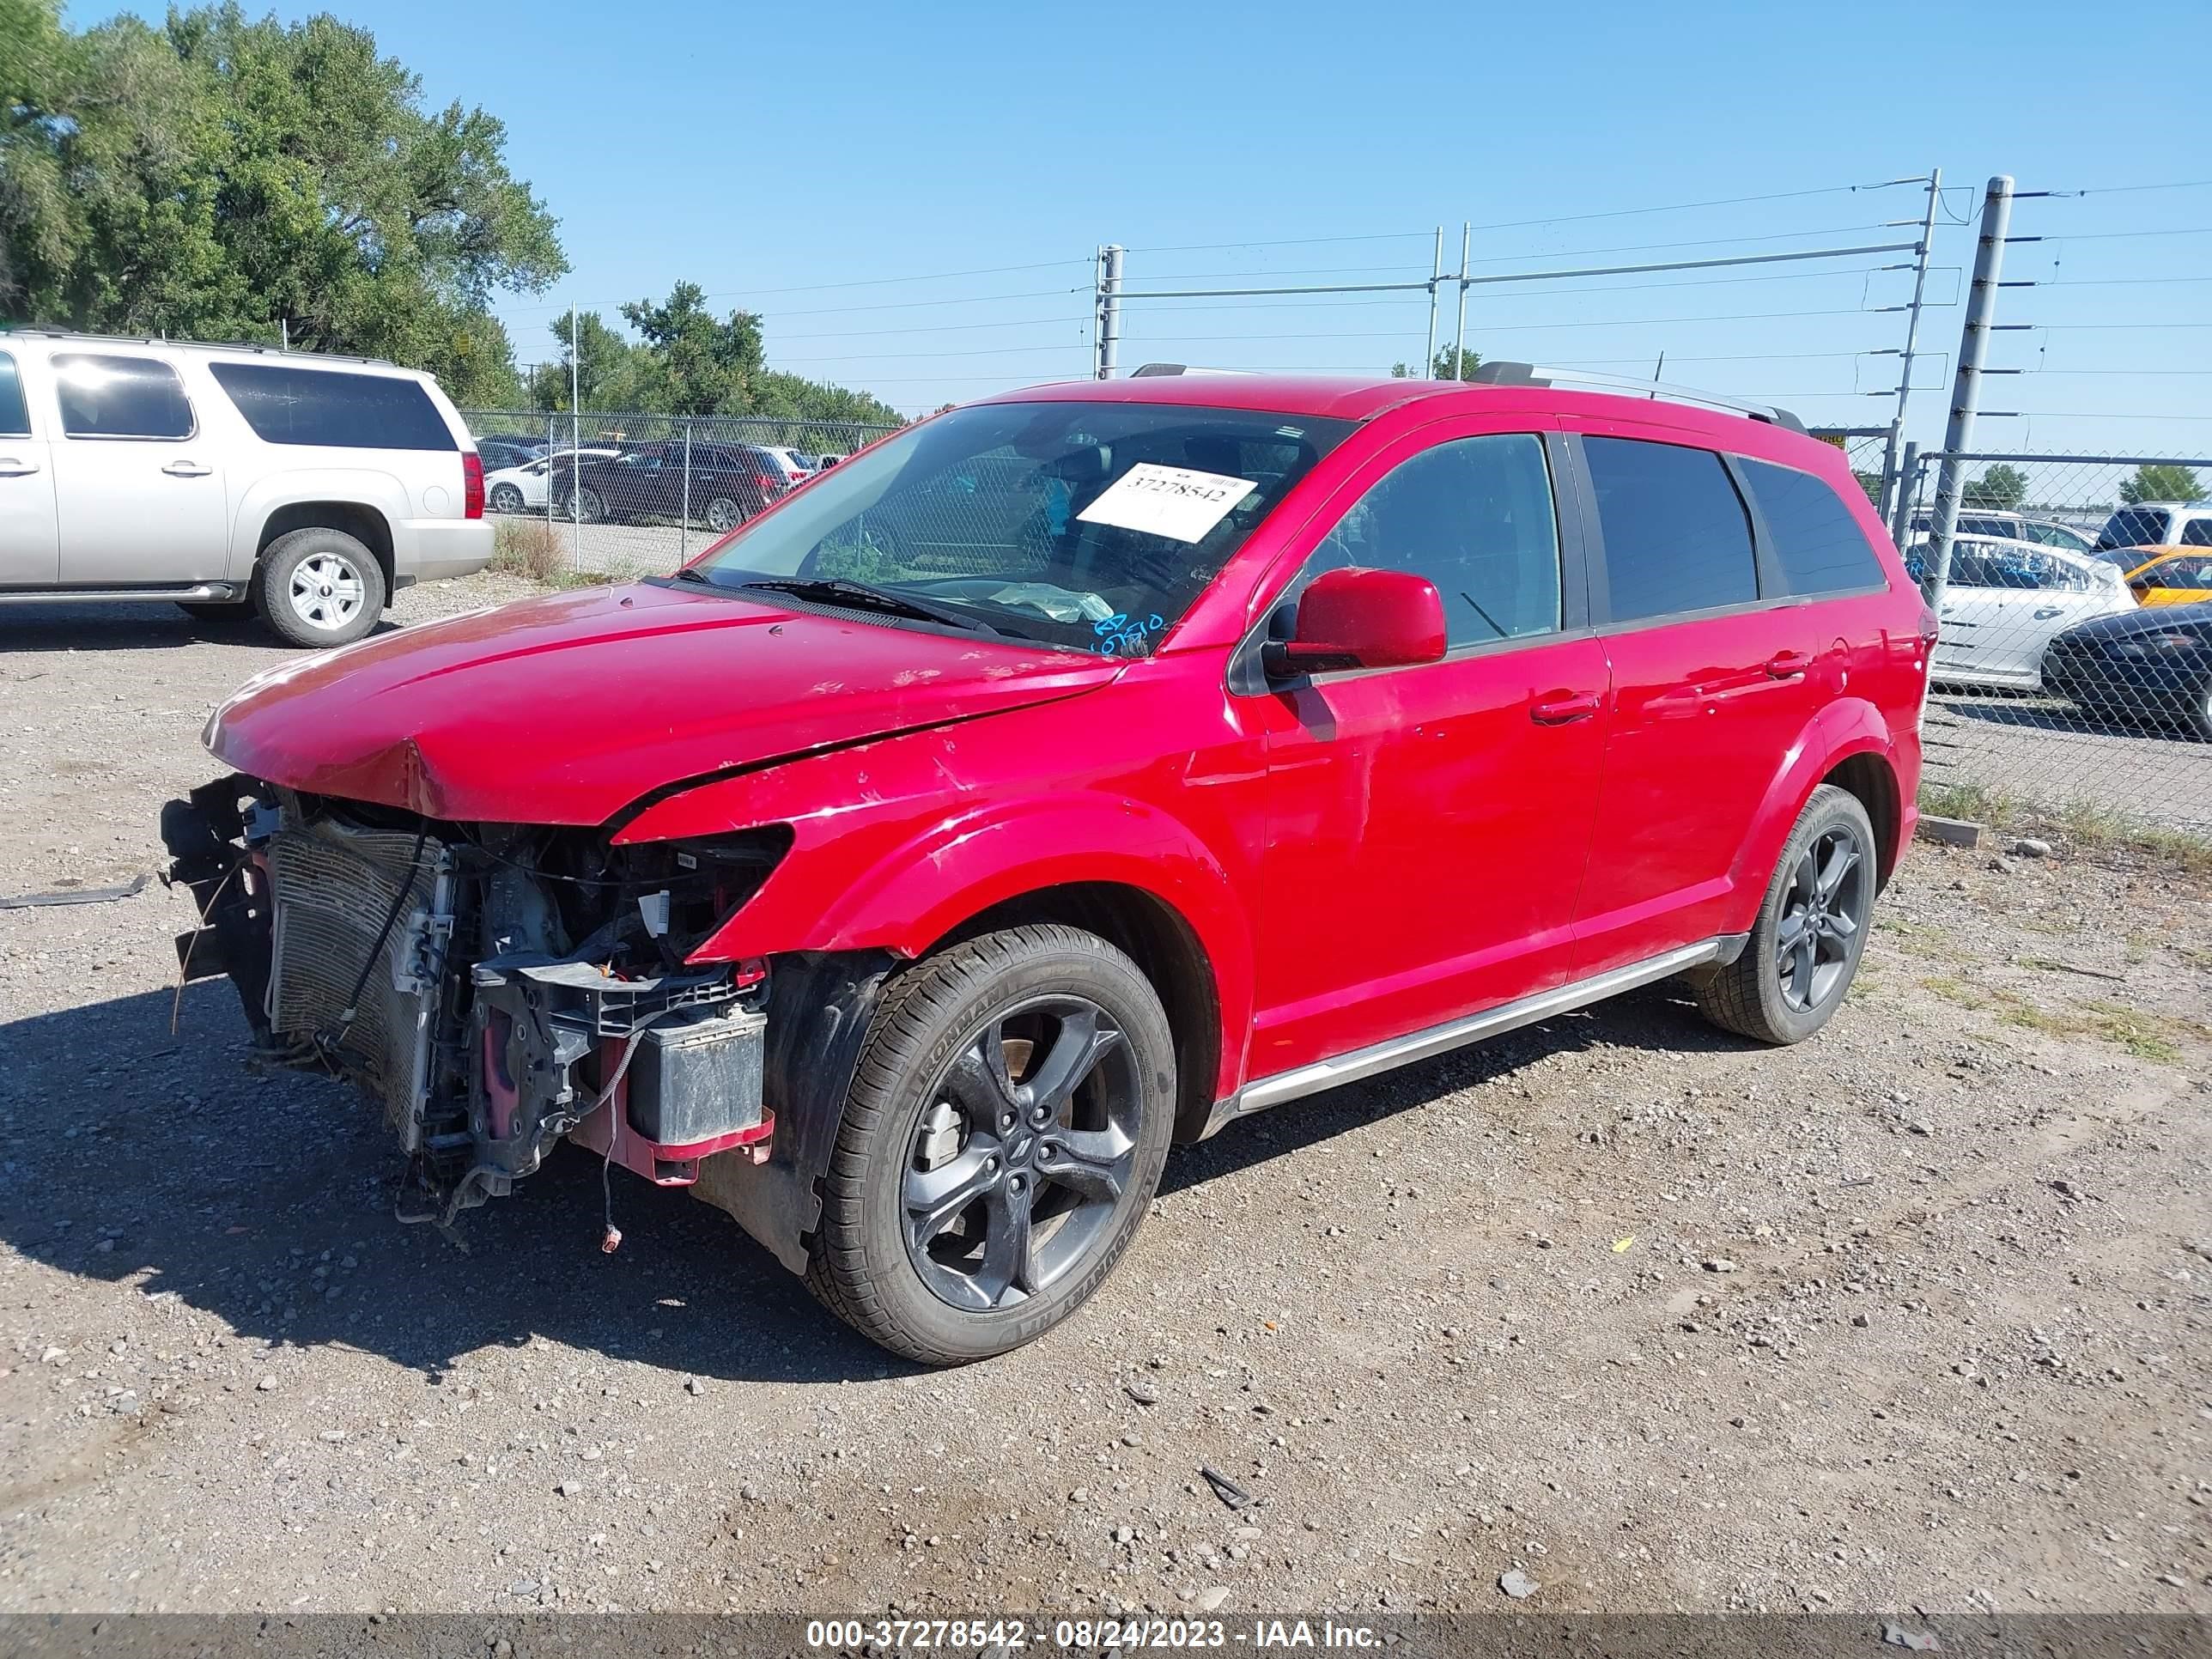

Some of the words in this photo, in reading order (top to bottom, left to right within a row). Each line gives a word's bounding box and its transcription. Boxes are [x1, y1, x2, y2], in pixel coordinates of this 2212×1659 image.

[1127, 477, 1227, 502] 37278542
[917, 989, 1000, 1085] IRONMAN
[1061, 1218, 1136, 1316] COUNTRY
